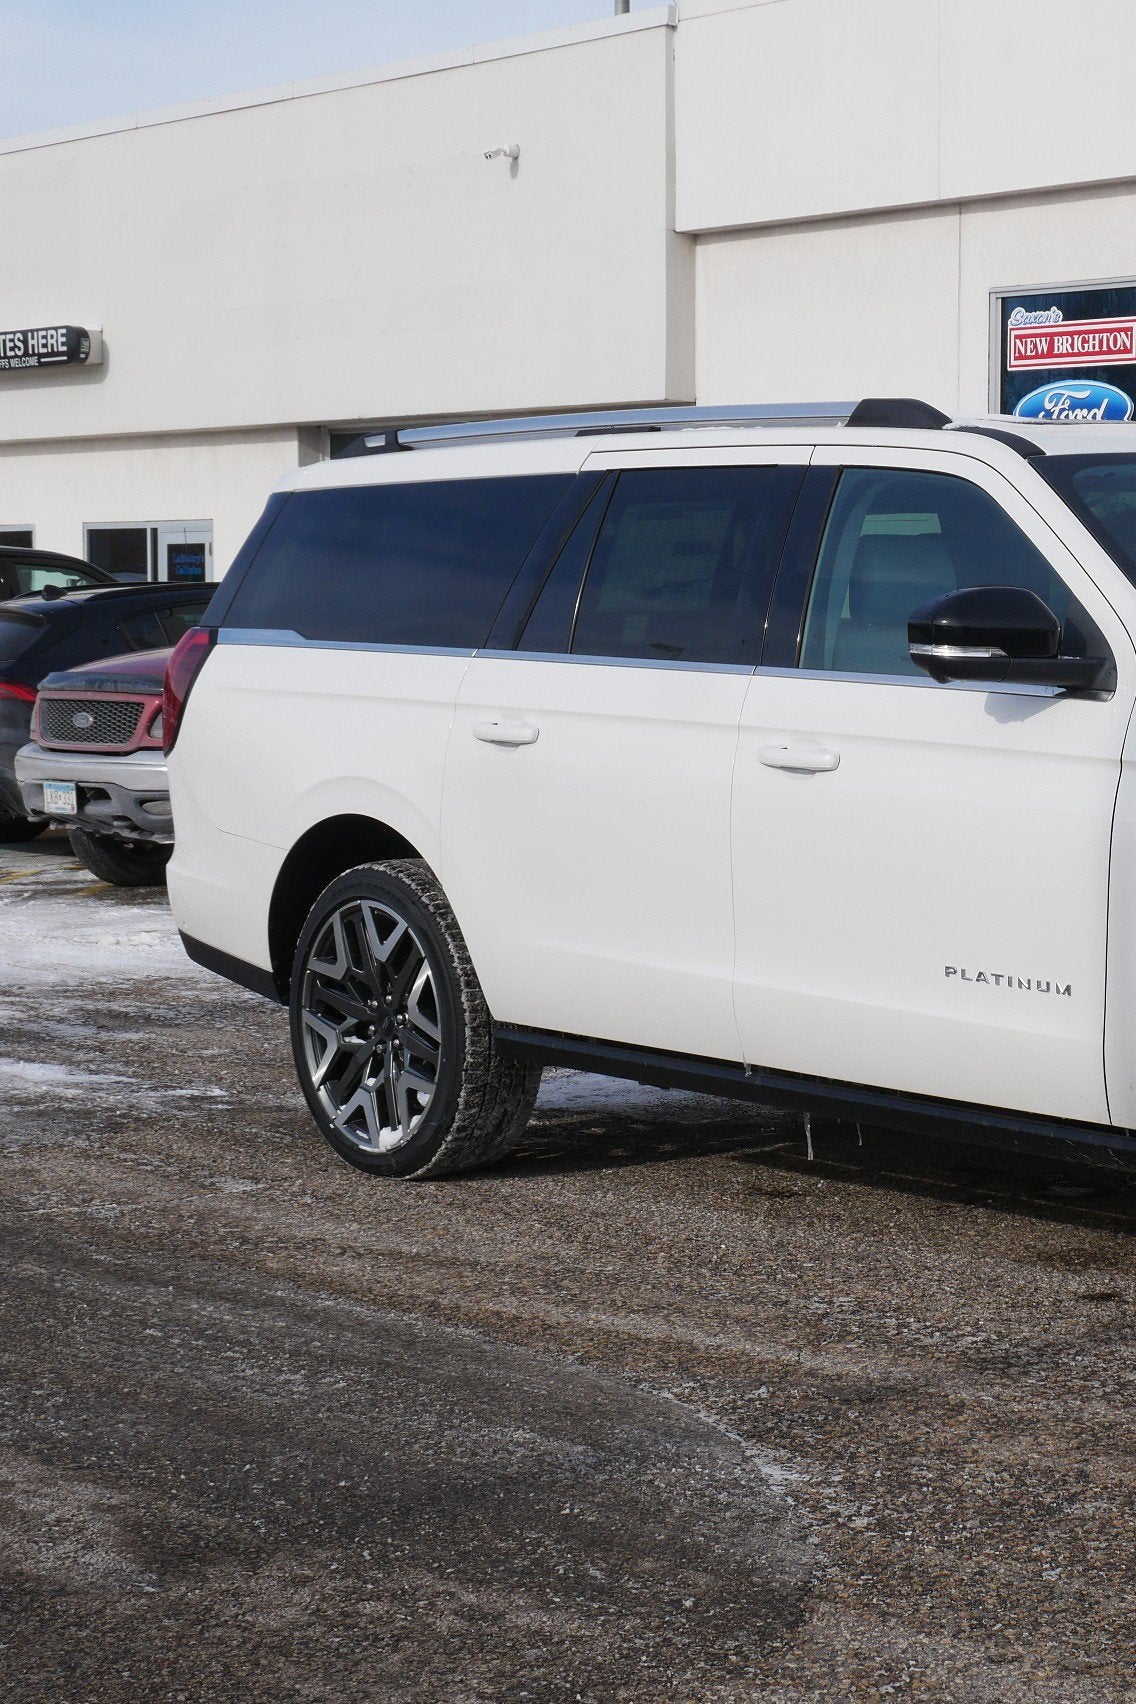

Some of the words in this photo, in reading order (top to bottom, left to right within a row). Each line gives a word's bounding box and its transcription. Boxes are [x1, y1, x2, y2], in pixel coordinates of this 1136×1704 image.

[1011, 307, 1061, 326] Saxon's
[28, 328, 68, 355] HERE
[1014, 336, 1050, 357] NEW
[1053, 331, 1132, 354] BRIGHTON
[10, 356, 39, 368] WELCOME
[944, 965, 1073, 998] PLATINUM
